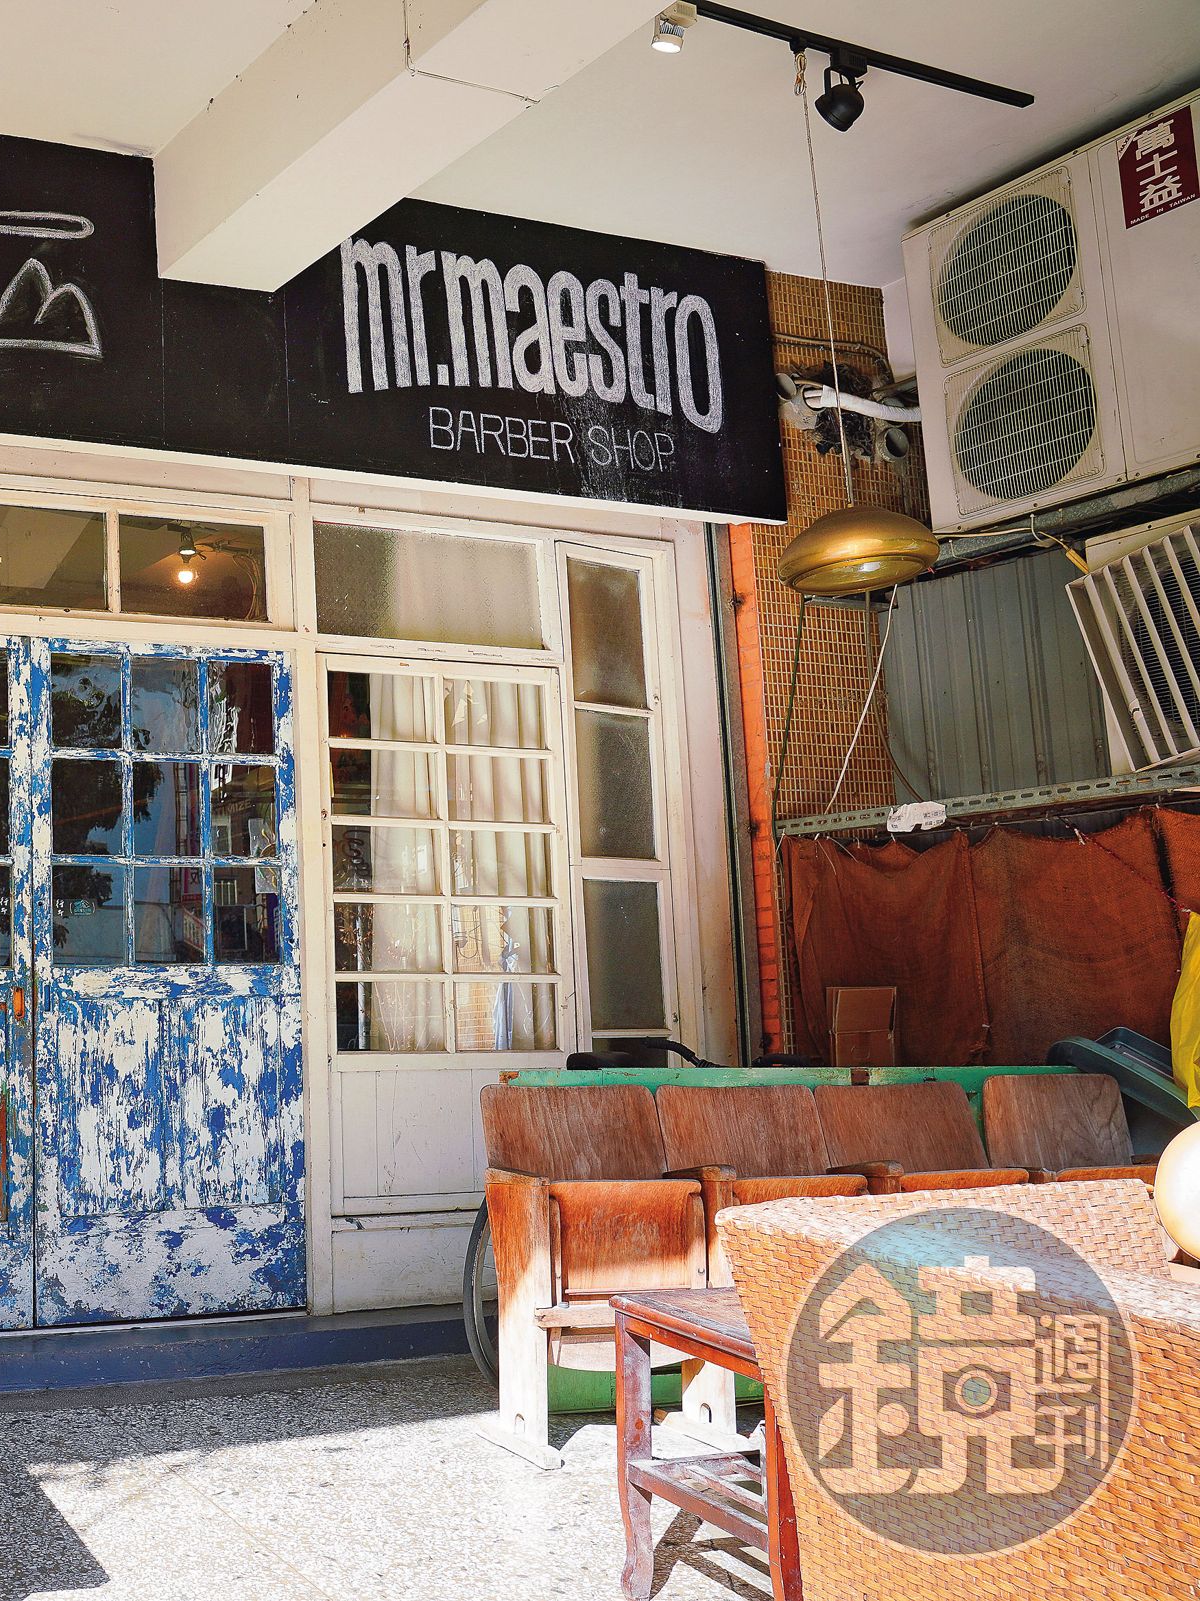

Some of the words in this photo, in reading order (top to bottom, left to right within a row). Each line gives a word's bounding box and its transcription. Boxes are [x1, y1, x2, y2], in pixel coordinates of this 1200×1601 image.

[1133, 119, 1183, 213] 萬士益
[1130, 213, 1150, 225] MADE
[1169, 193, 1196, 208] TAIWAN
[339, 236, 723, 434] mr.maestro
[429, 406, 576, 465] BARBER
[587, 425, 676, 475] SHOP
